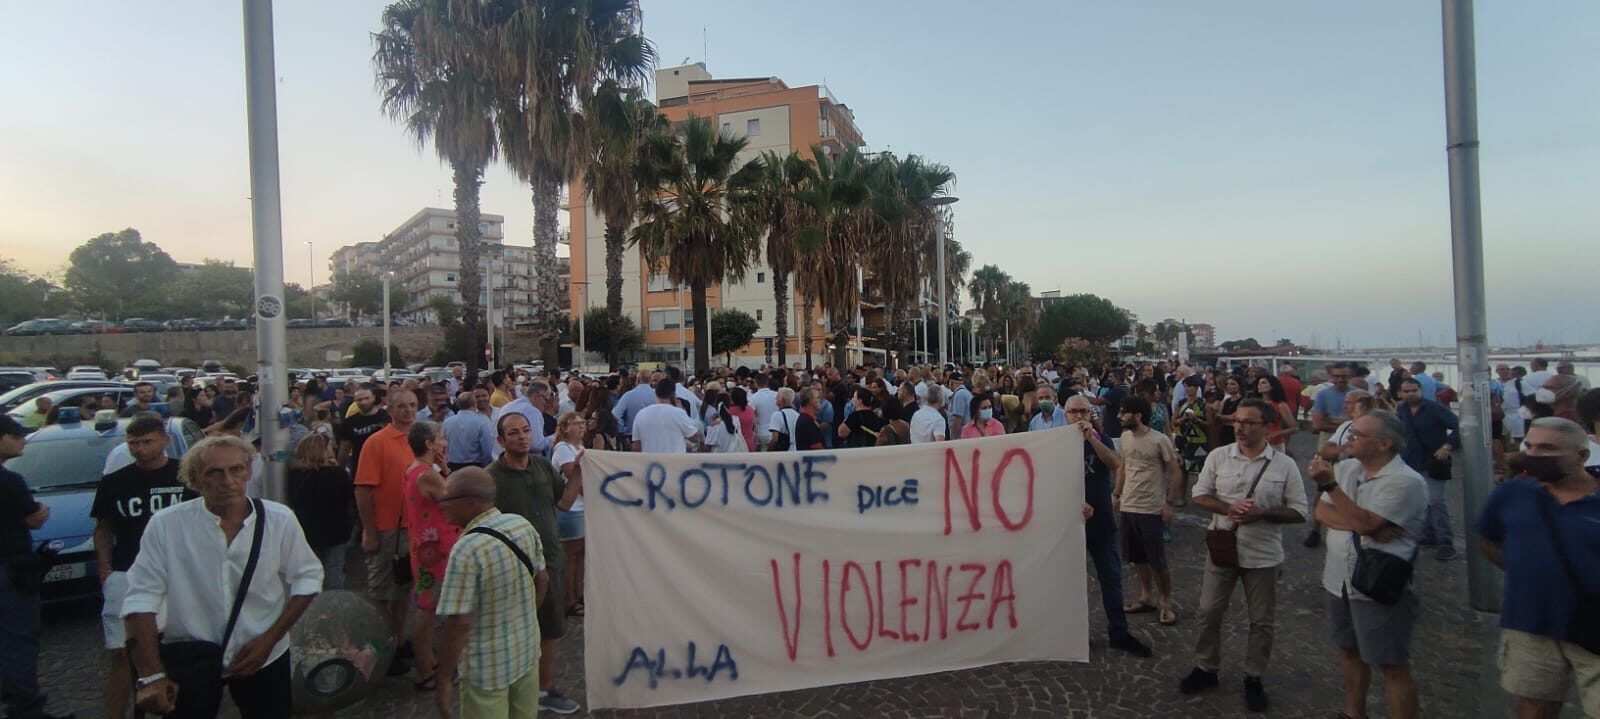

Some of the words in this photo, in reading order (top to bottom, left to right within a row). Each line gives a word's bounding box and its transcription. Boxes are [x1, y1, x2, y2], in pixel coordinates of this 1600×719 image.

[600, 453, 837, 511] CROTONE
[857, 479, 919, 513] DICE
[944, 448, 1035, 534] NO
[615, 643, 739, 687] ALLA
[771, 553, 1018, 661] VIOLENZA
